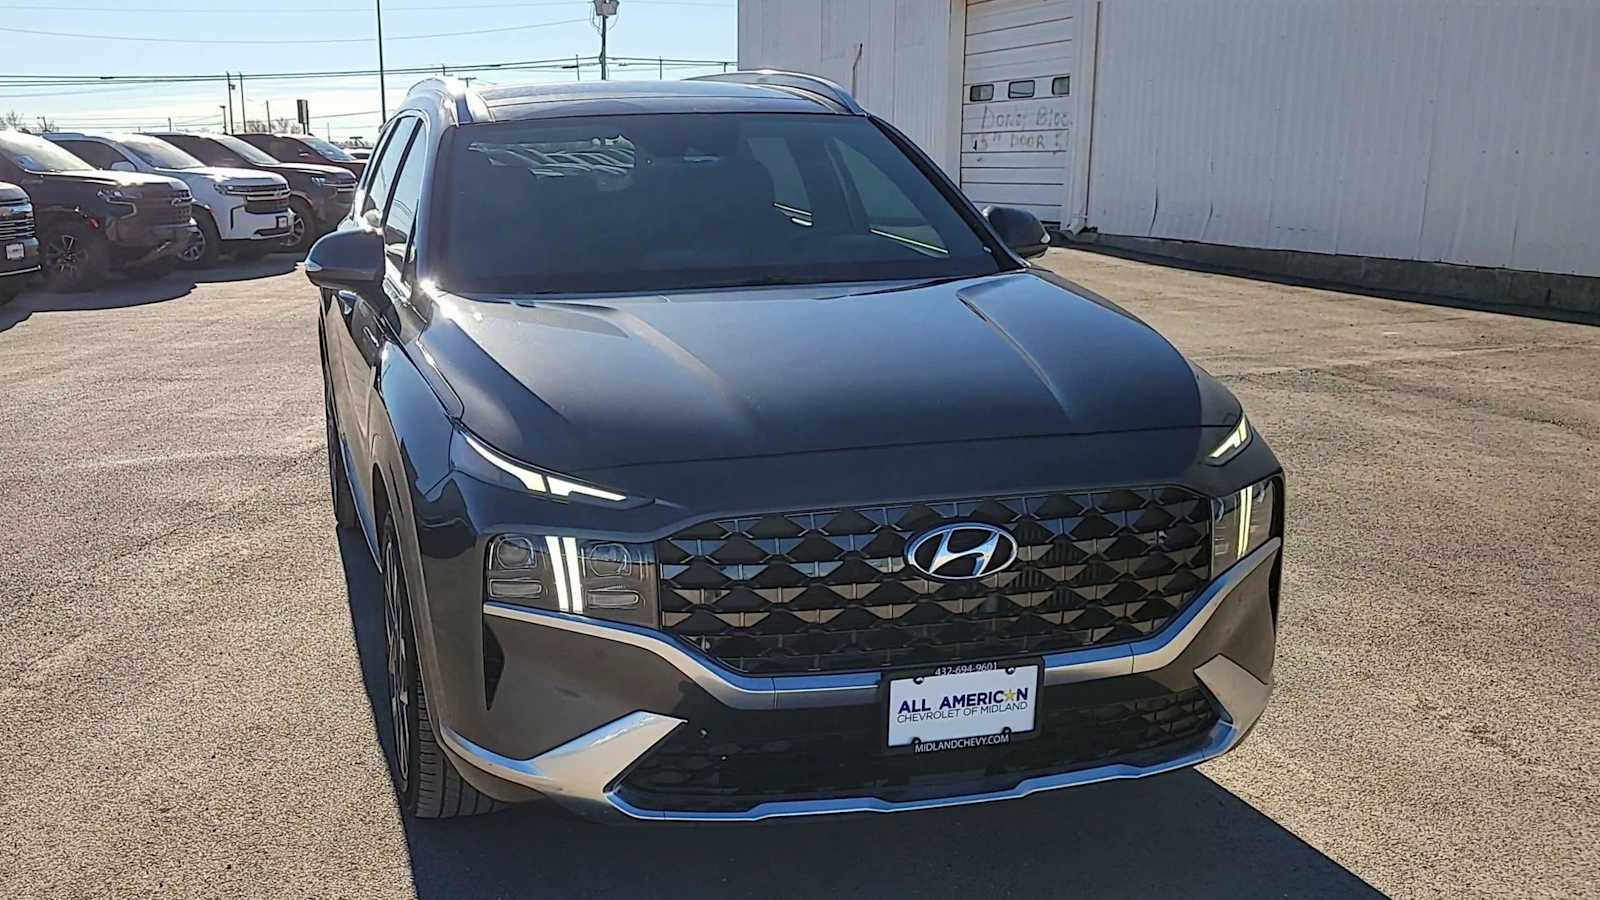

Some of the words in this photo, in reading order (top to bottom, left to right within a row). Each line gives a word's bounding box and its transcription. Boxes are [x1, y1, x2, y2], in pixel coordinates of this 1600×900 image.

[935, 661, 997, 676] 432-694-9601
[896, 708, 960, 723] CHEVROLET
[963, 707, 978, 717] OF
[981, 701, 1028, 713] MIDLAND
[898, 698, 931, 714] ALL
[914, 734, 1010, 753] MIDLANDCHEVY.COM
